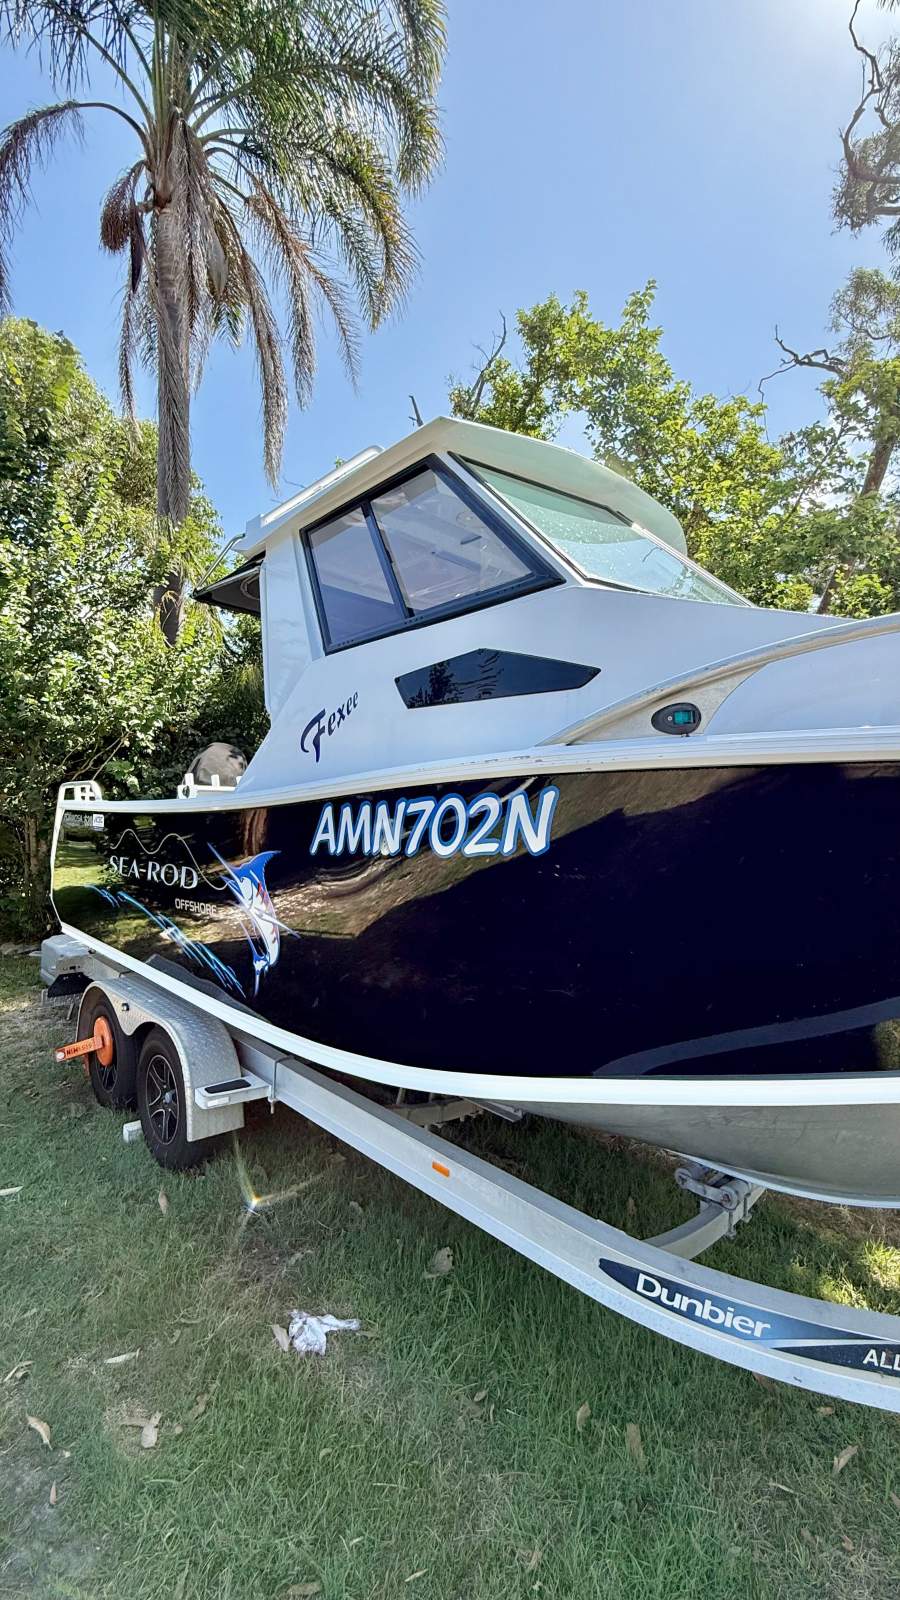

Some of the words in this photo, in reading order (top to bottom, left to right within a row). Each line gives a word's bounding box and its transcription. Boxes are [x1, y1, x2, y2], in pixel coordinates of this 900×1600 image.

[300, 691, 359, 763] Fexee
[310, 786, 560, 857] AMN702N
[109, 855, 199, 889] SEA-ROD
[174, 898, 217, 915] OFFSHORE
[636, 1272, 771, 1338] Dunbier
